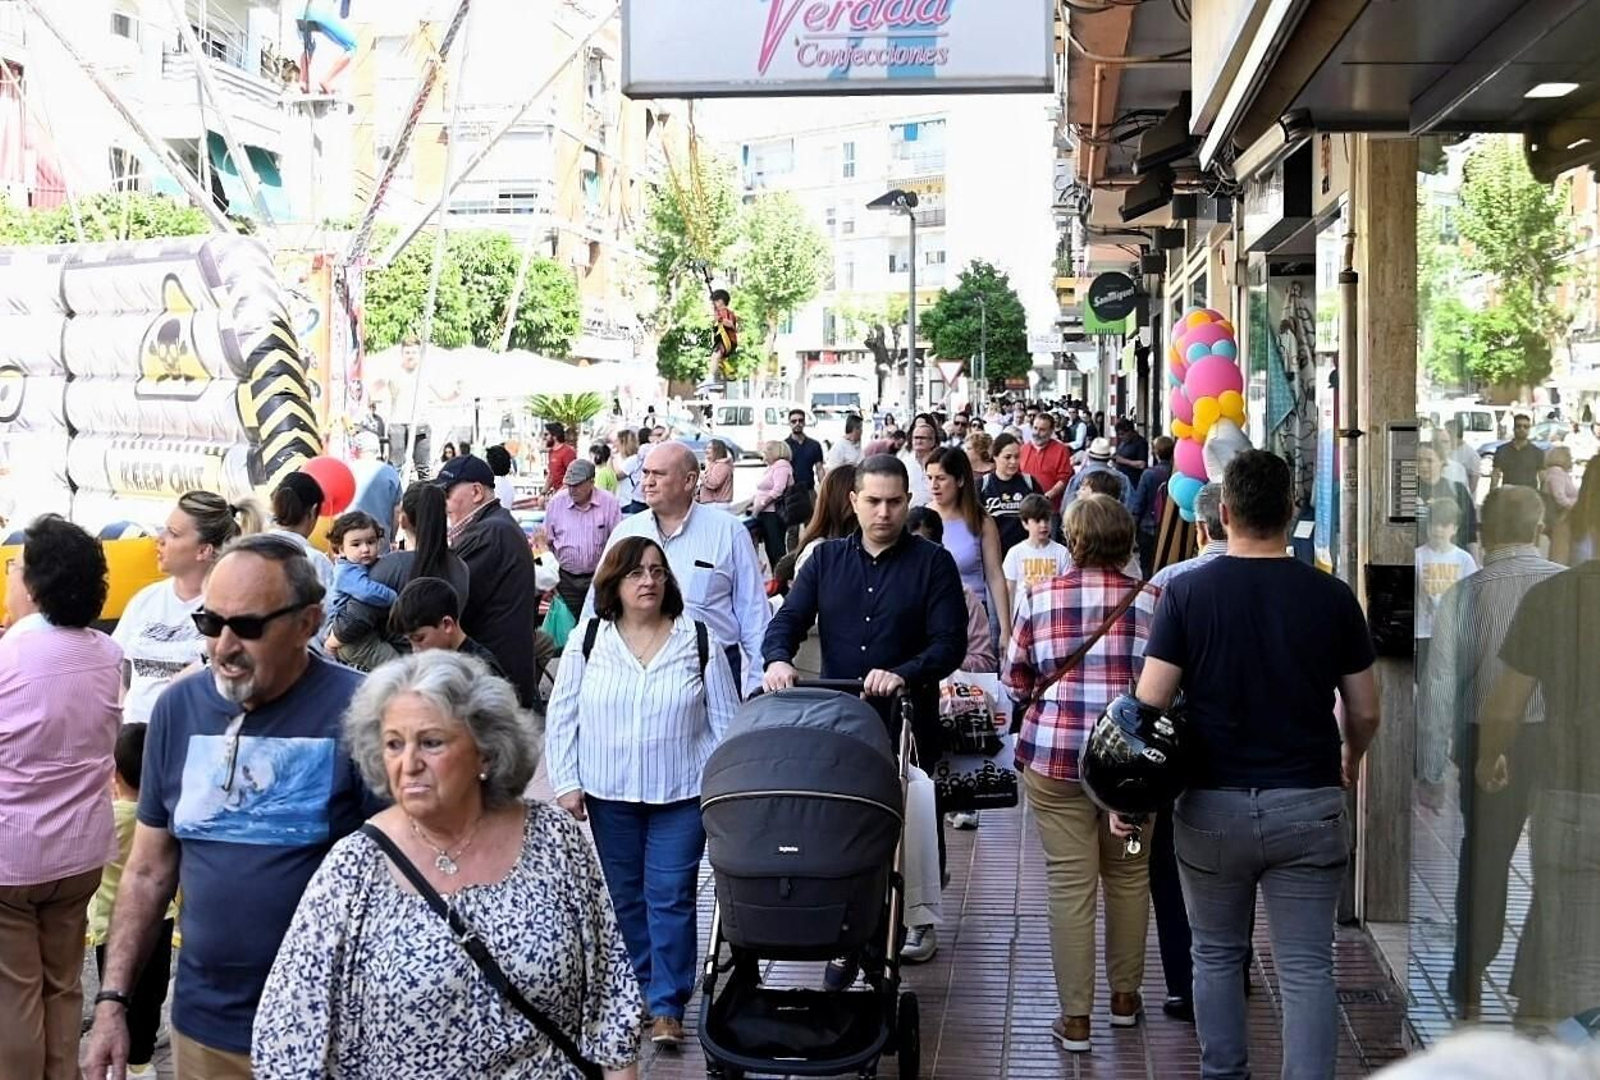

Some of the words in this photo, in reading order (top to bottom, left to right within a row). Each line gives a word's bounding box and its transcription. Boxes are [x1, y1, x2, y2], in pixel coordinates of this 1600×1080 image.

[797, 41, 949, 74] Confecciones
[120, 461, 164, 492] KEEP
[169, 463, 204, 494] OUT
[984, 497, 1020, 513] Pean
